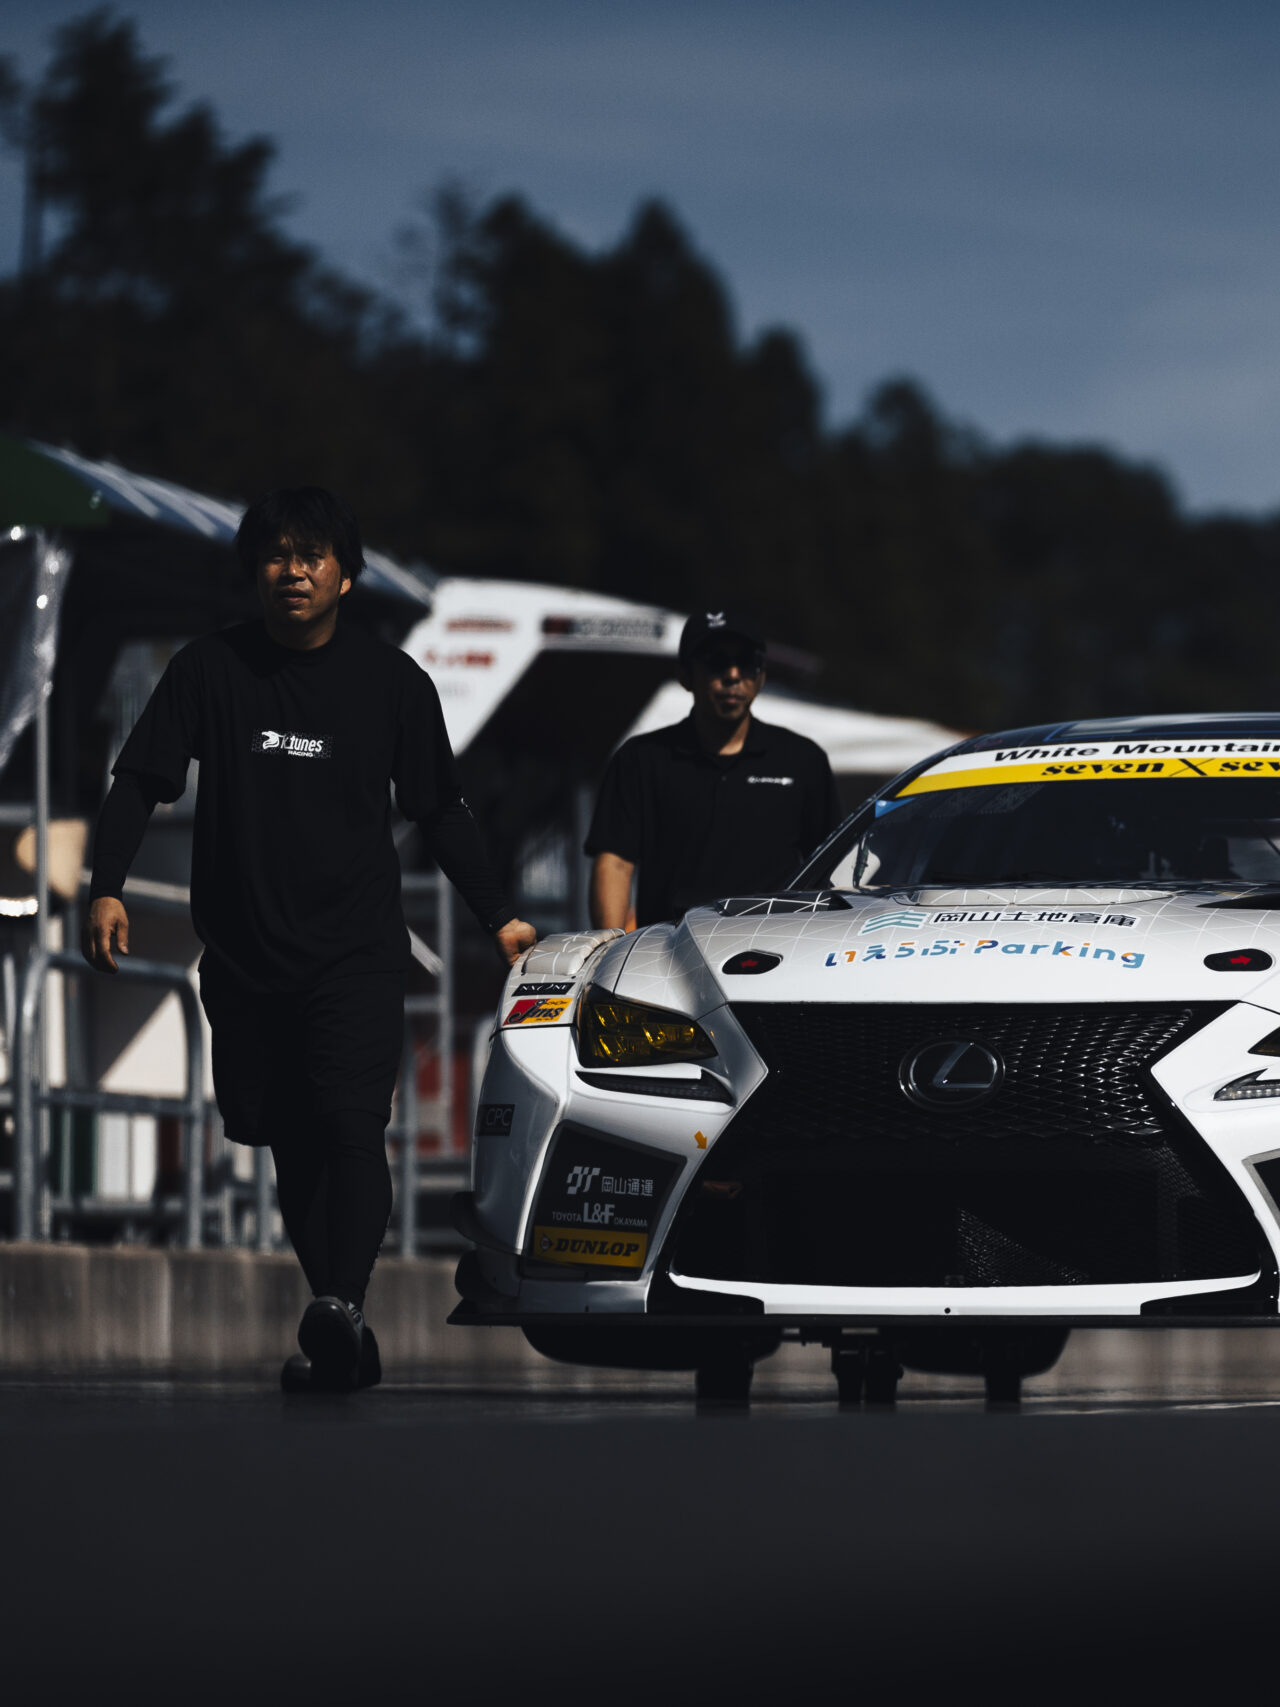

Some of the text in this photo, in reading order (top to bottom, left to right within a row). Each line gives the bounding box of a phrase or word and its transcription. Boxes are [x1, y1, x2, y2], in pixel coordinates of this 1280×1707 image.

[994, 746, 1100, 762] White
[1041, 761, 1165, 776] seven
[933, 911, 1137, 928] 岡山土地倉庫
[975, 939, 1146, 969] Parking
[601, 1176, 653, 1196] 岡山通運
[552, 1202, 648, 1228] TOYOTA L&F OKAYAMA
[555, 1238, 640, 1257] DUNLOP
